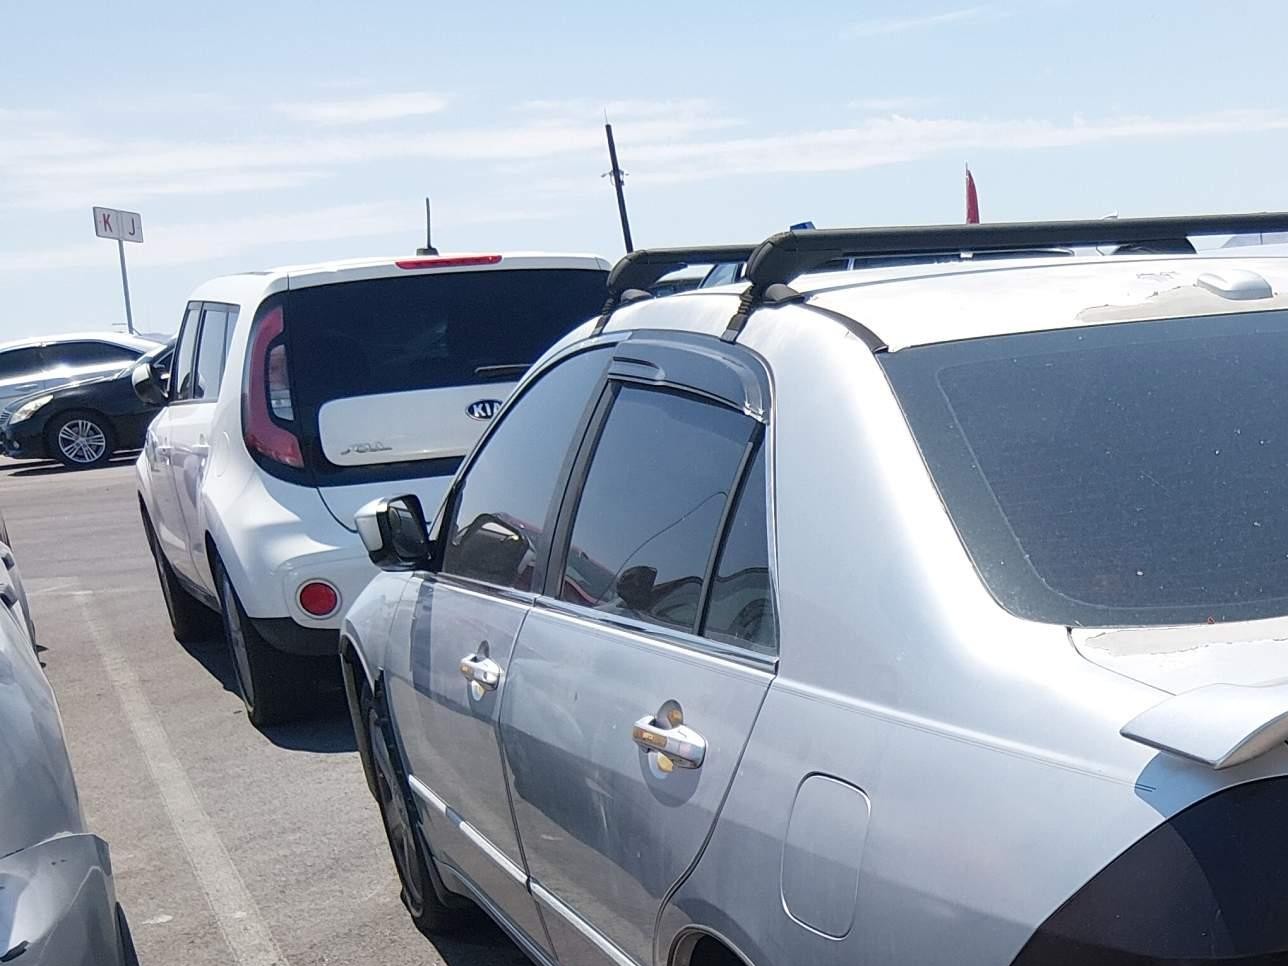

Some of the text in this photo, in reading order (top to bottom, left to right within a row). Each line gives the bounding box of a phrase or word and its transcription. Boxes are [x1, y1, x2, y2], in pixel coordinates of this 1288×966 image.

[102, 213, 136, 236] K J
[472, 402, 502, 417] KIA
